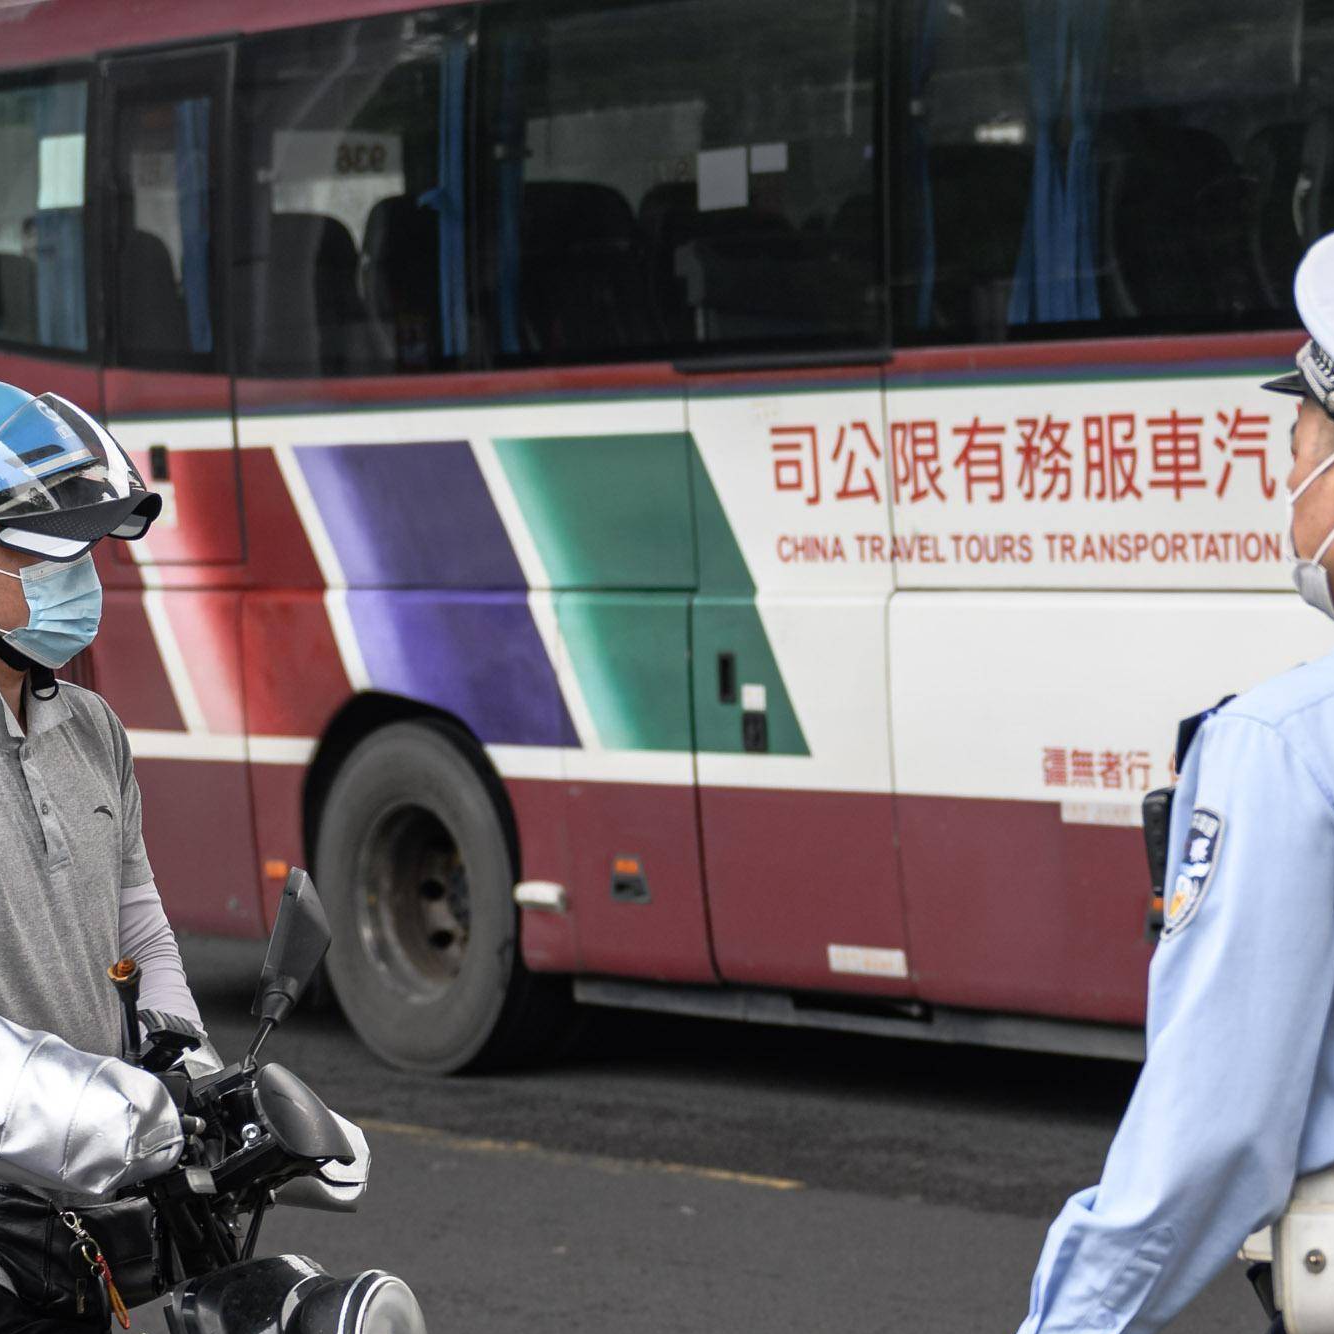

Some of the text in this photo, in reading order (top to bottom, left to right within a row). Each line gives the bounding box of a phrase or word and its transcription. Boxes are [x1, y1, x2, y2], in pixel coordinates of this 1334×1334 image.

[776, 533, 847, 563] CHINA
[855, 533, 947, 563] TRAVEL
[952, 533, 1034, 563] TOURS
[1044, 532, 1282, 563] TRANSPORTATION
